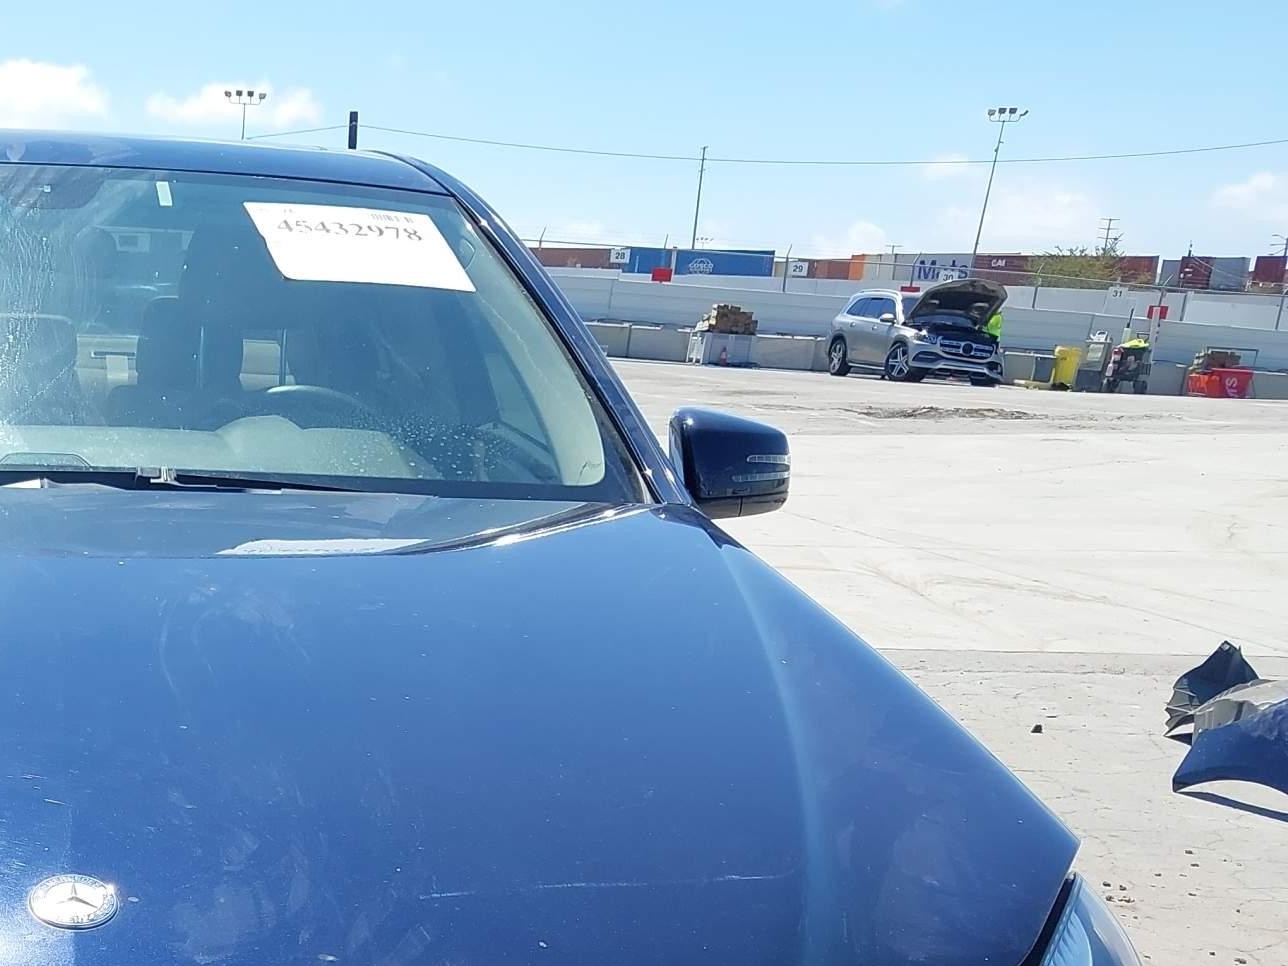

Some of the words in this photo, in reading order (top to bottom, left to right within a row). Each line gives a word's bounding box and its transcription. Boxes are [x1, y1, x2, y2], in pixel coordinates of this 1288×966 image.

[277, 219, 423, 241] 45432978
[615, 252, 626, 260] 28
[792, 264, 804, 273] 29
[943, 273, 954, 281] 30
[1112, 289, 1123, 298] 31
